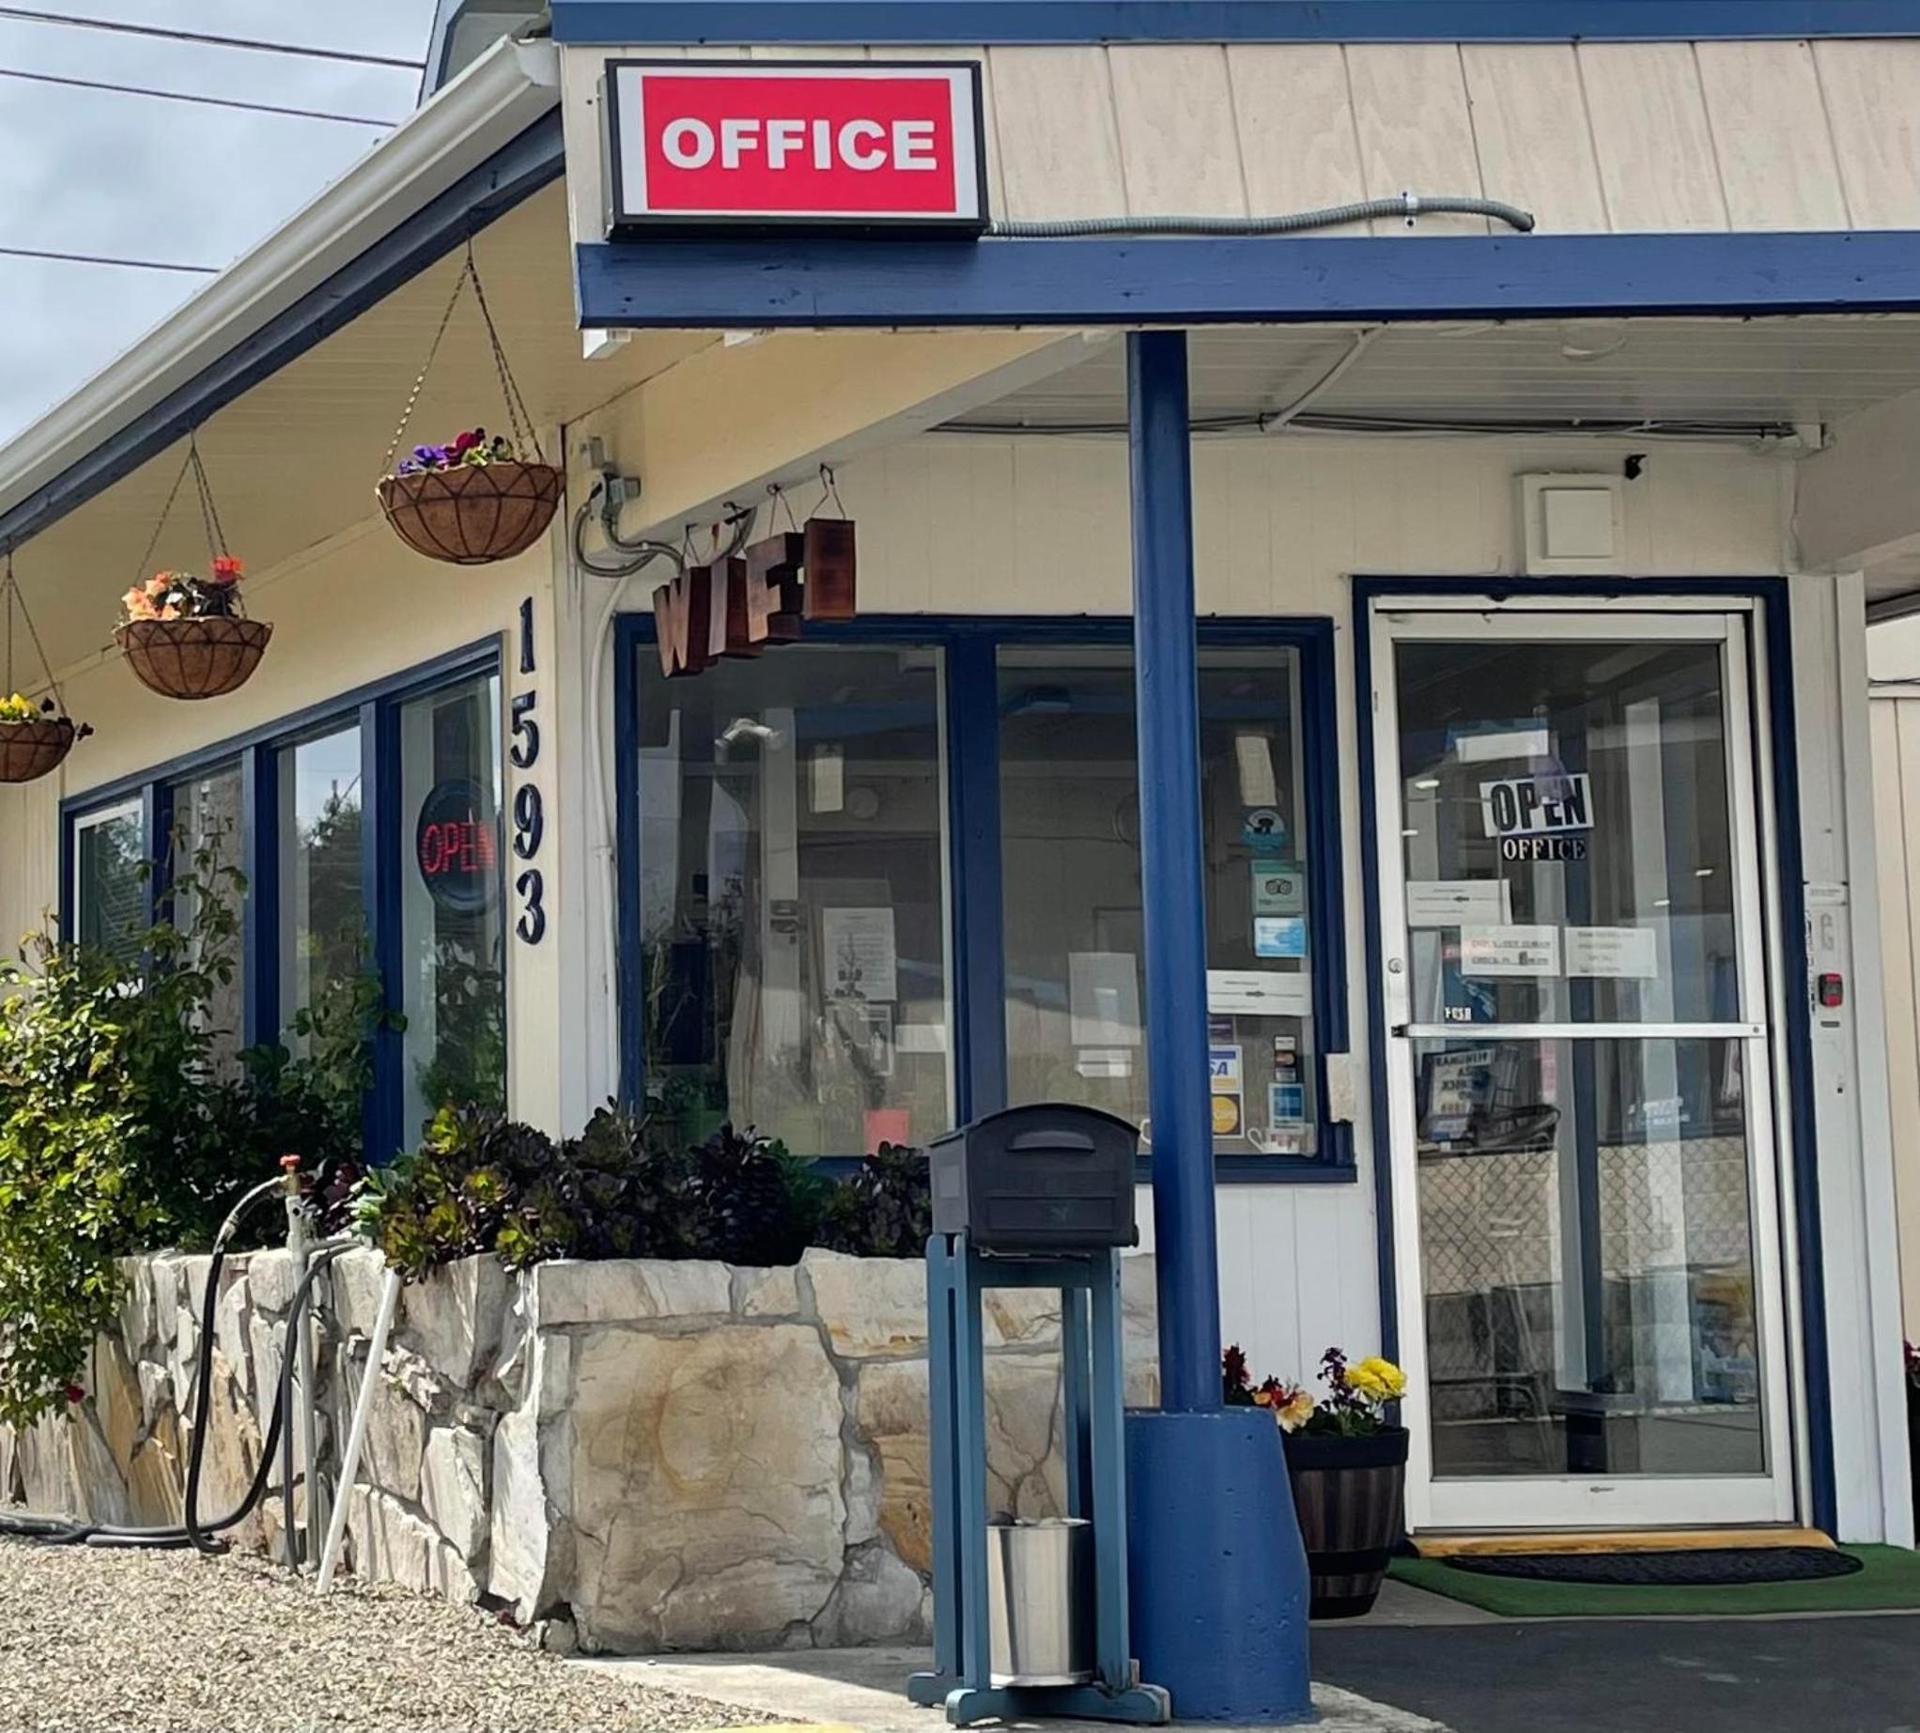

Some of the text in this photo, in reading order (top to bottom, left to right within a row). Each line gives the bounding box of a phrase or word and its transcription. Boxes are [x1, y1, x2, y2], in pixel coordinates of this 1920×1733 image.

[661, 117, 938, 171] OFFICE
[509, 596, 545, 945] 1593
[1490, 777, 1587, 832] OPEN
[1503, 838, 1586, 860] OFFICE
